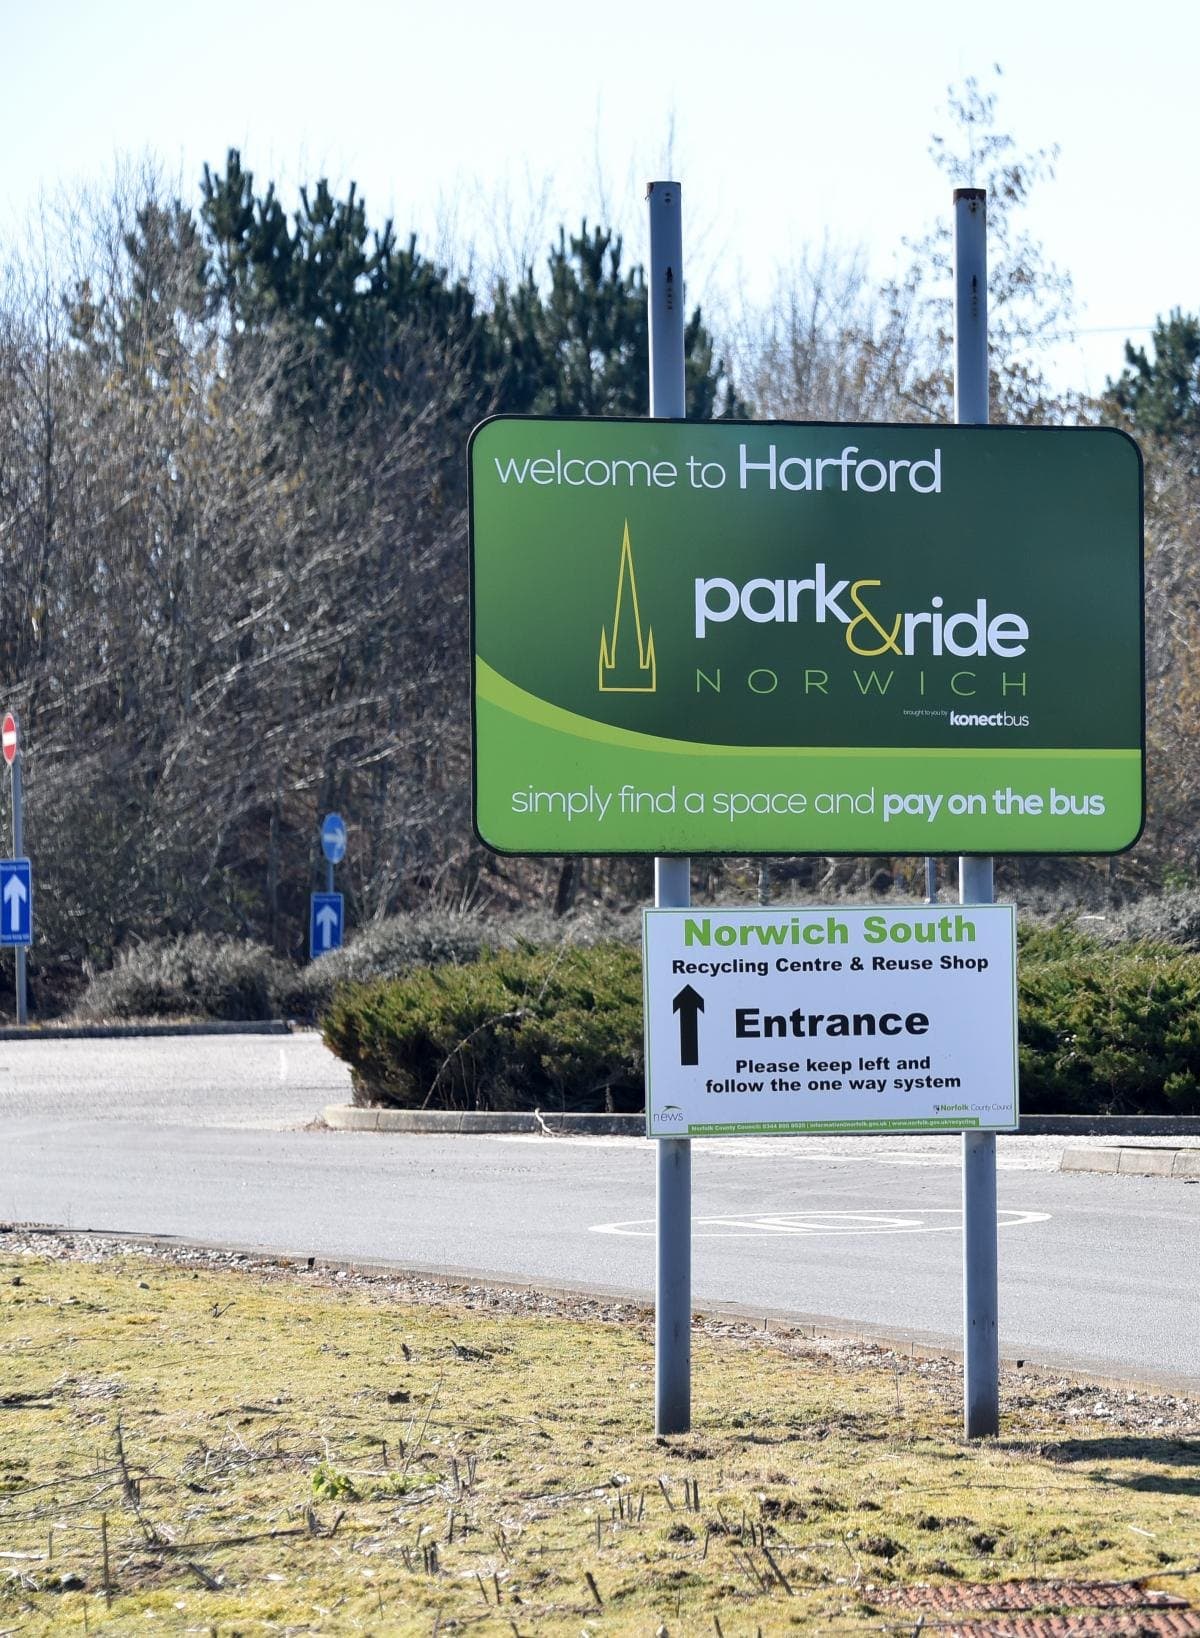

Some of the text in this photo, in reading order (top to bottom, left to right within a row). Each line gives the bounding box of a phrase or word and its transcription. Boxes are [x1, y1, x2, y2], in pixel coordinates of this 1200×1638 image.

[494, 443, 942, 494] welcome to Harford
[696, 668, 1026, 697] NORWICH
[949, 710, 1030, 727] konectbus
[511, 784, 1106, 823] simply find a space and pay on the bus
[684, 915, 976, 947] Norwich South
[672, 955, 989, 978] Recycling Centre & Reuse Shop
[735, 1007, 930, 1039] Entrance
[735, 1055, 931, 1075] Please keep left and
[705, 1075, 961, 1094] follow the one way system
[653, 1113, 684, 1122] news
